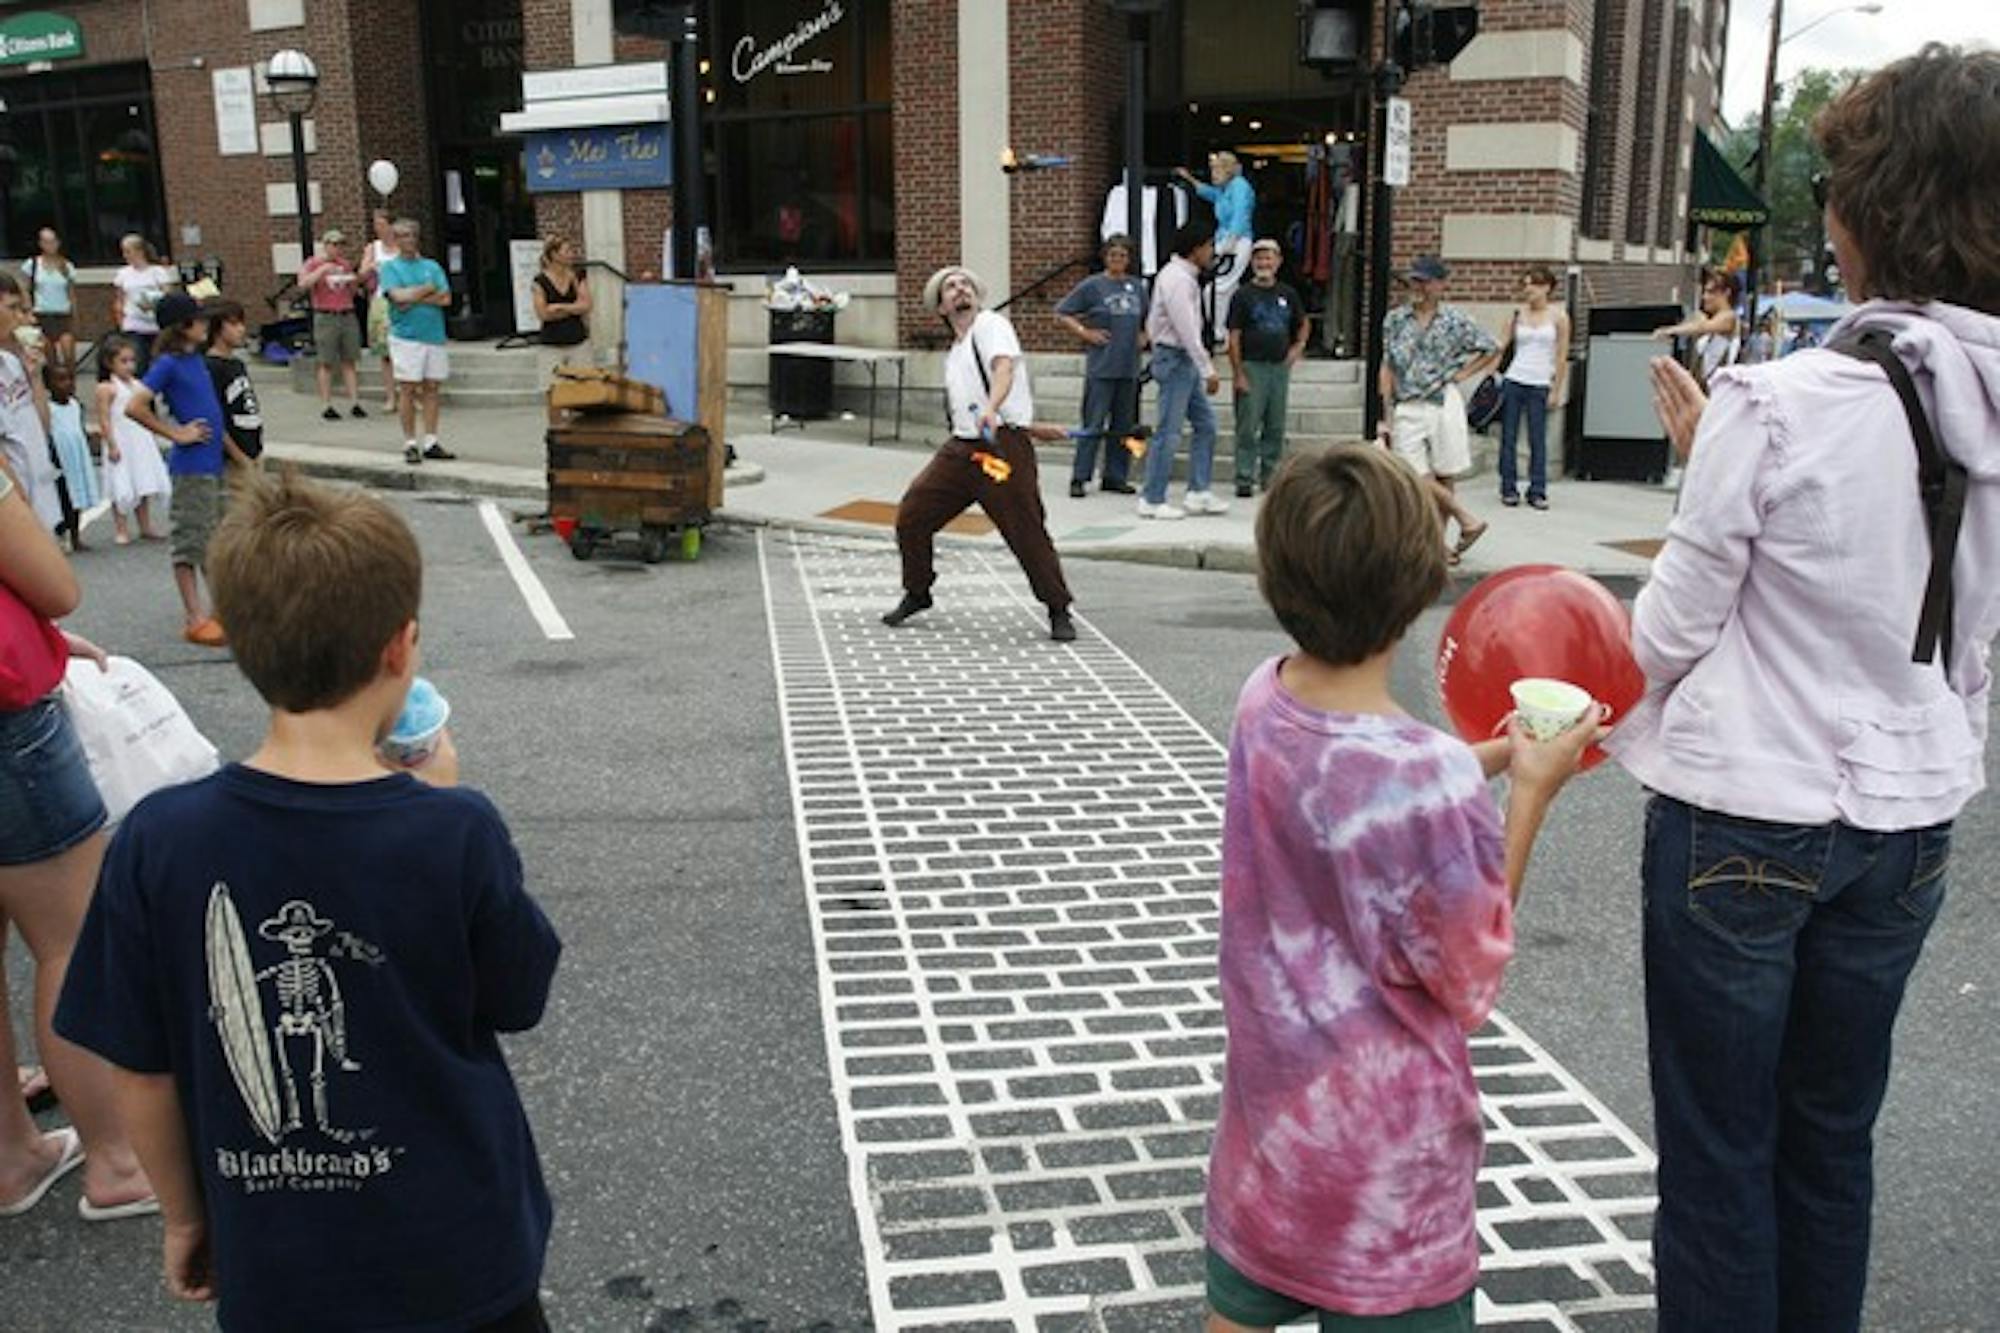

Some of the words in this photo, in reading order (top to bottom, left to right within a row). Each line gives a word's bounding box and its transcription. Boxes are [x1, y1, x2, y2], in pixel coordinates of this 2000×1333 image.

[8, 36, 48, 55] Citizens
[47, 29, 75, 51] Bank
[731, 0, 845, 82] Campion's
[215, 1147, 392, 1178] Blackbeard's
[287, 1176, 363, 1192] Company
